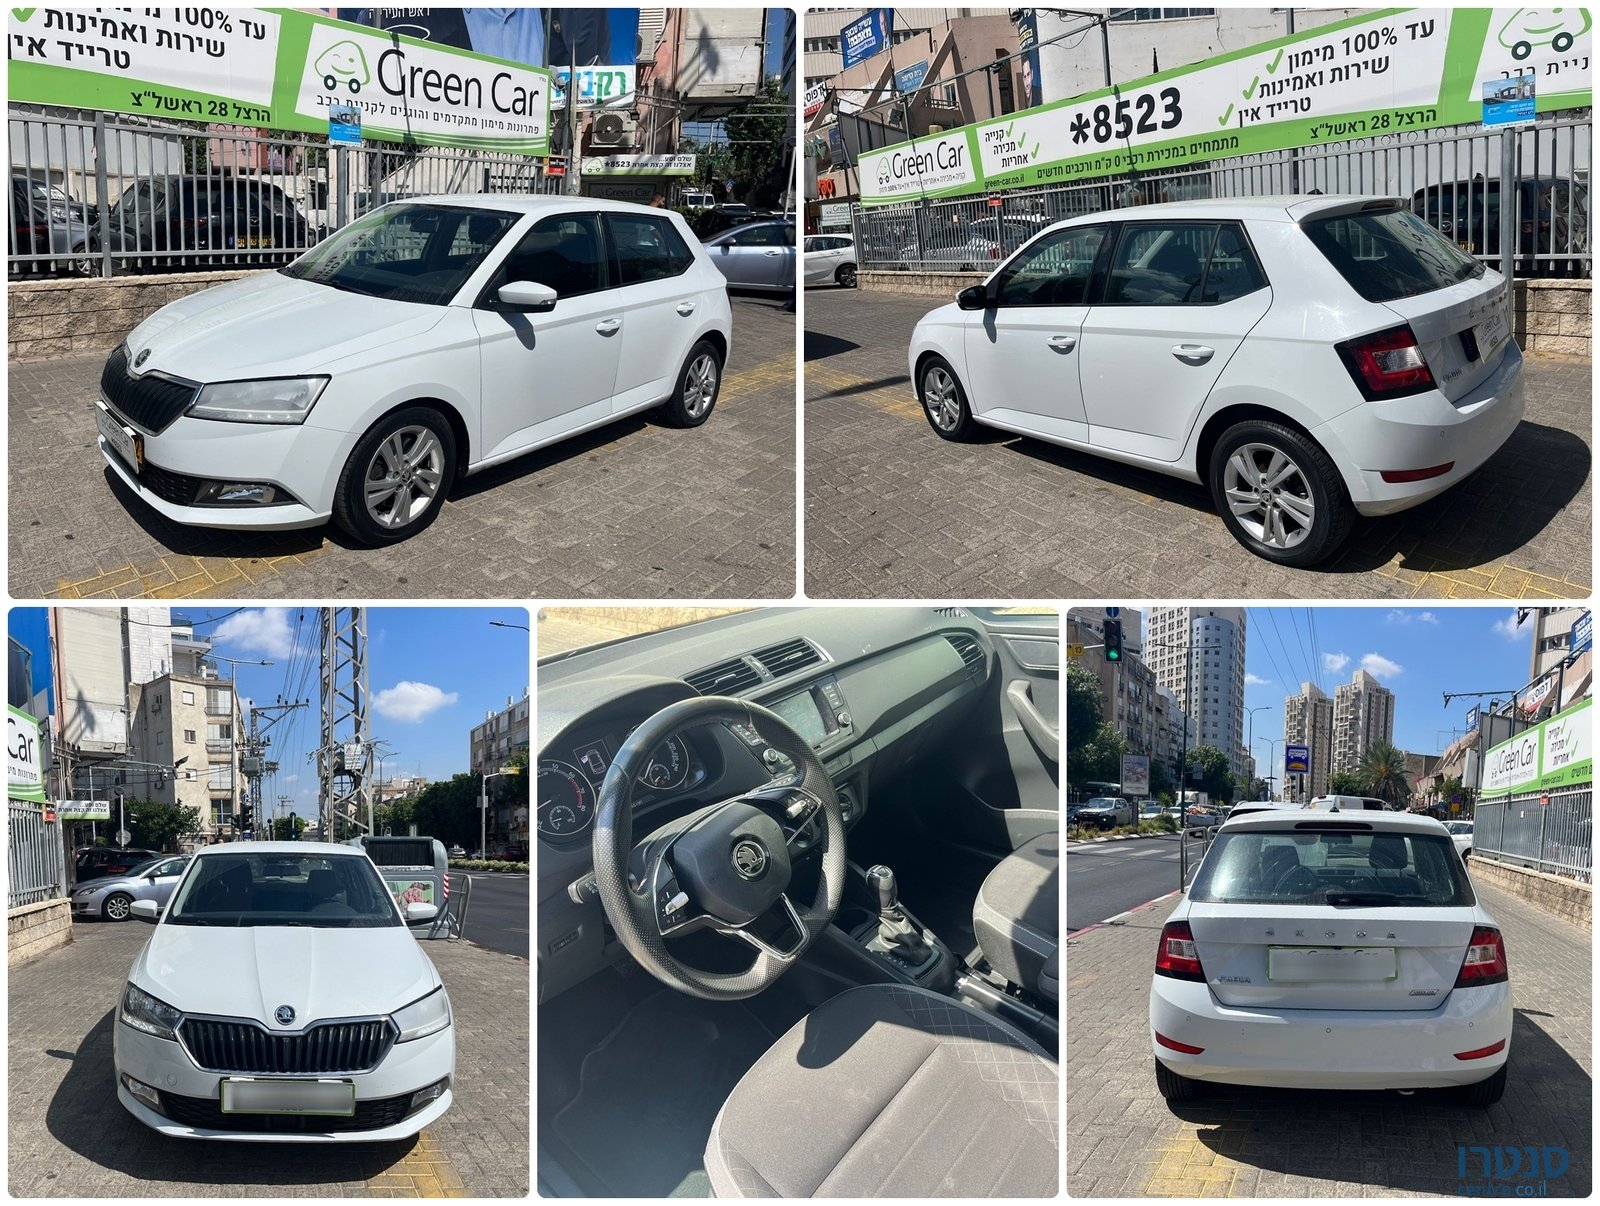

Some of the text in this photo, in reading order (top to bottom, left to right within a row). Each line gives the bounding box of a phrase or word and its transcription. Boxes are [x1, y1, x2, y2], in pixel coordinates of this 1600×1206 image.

[44, 8, 225, 58] שירות ואמינות
[239, 19, 266, 40] עד
[1288, 18, 1435, 74] עד 100% מימון
[56, 41, 130, 69] טרייד
[377, 48, 482, 109] Green
[491, 72, 540, 117] Car
[1259, 56, 1390, 99] שירות ואמינות
[208, 100, 228, 116] 28
[232, 102, 270, 122] הרצל
[390, 106, 428, 120] והוגנים
[1238, 96, 1312, 128] טרייד אין
[432, 112, 478, 126] מתקדמים
[481, 118, 504, 130] מימון
[1370, 114, 1390, 130] 28
[1394, 108, 1437, 127] הרצל
[506, 121, 540, 134] פתרונות
[985, 129, 1004, 142] קנייה
[994, 141, 1016, 155] מכירה
[1190, 135, 1239, 154] מתמחים
[892, 141, 964, 178] Green Car
[1002, 154, 1028, 168] אחריות
[1122, 152, 1144, 166] רכבי
[1146, 145, 1186, 164] במכירת
[1037, 166, 1064, 178] חדשים
[1066, 160, 1092, 174] ורכבים
[984, 174, 1024, 190] green-car.co.il
[1075, 646, 1082, 654] 13
[1498, 738, 1536, 774] Green Car
